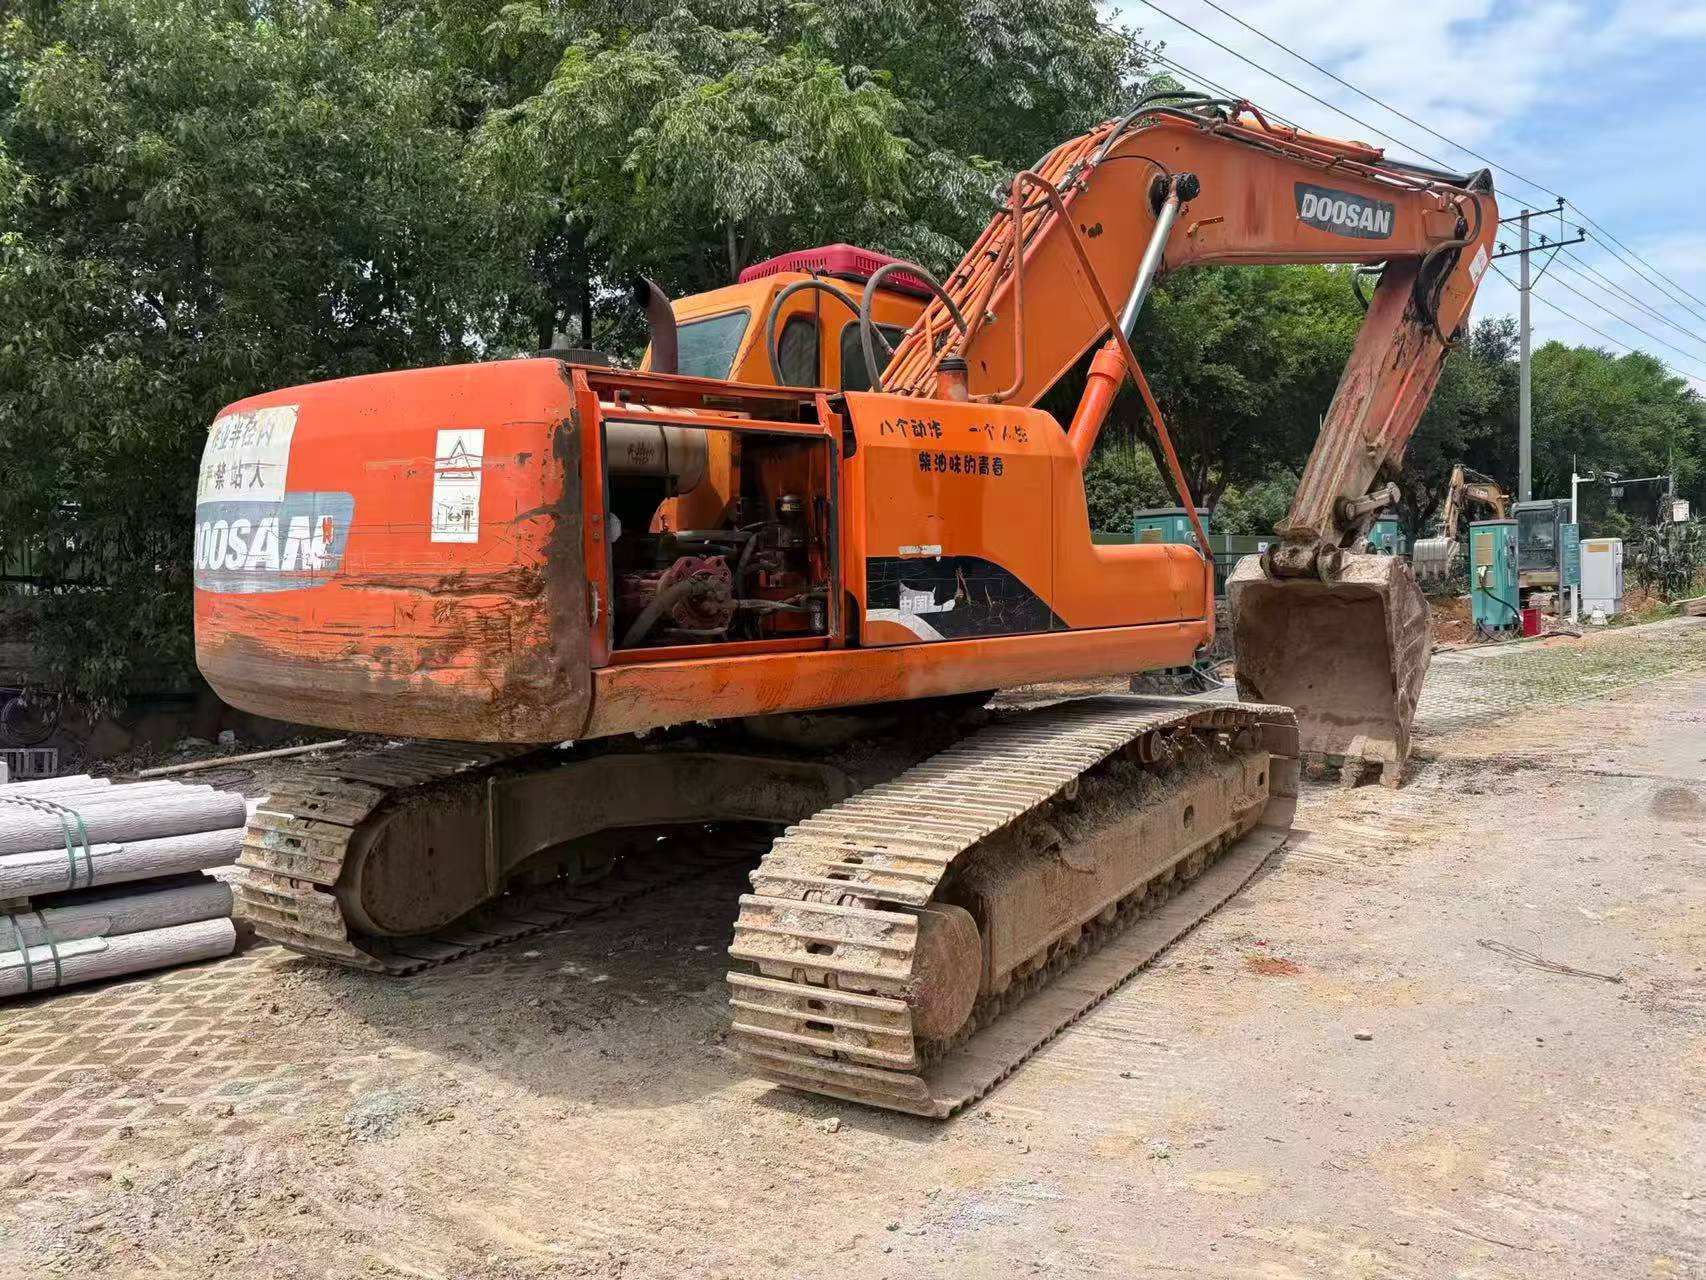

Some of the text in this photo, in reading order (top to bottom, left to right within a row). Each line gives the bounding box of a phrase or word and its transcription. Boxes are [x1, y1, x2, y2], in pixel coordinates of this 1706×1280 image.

[1301, 193, 1390, 233] DOOSAN
[880, 418, 942, 439] 八个动作
[918, 451, 1004, 476] 柴油味的青春
